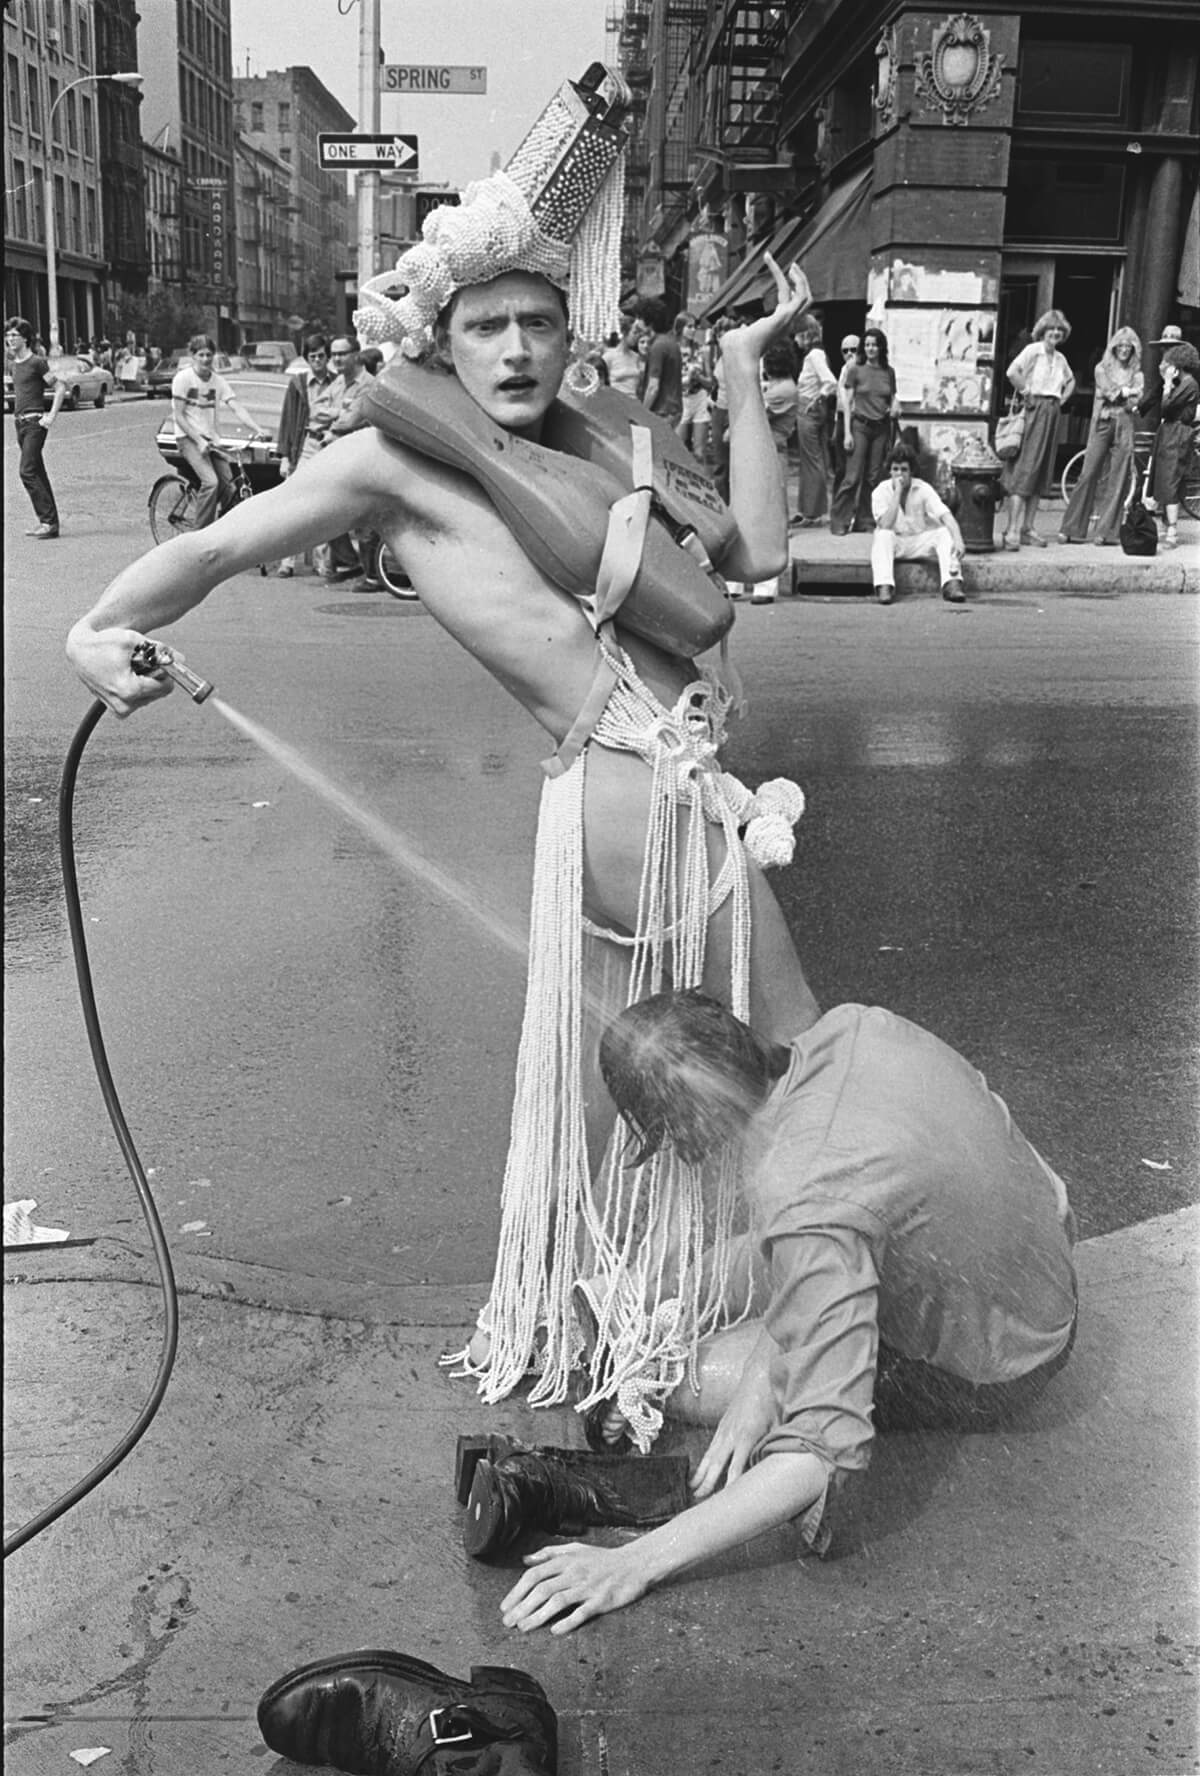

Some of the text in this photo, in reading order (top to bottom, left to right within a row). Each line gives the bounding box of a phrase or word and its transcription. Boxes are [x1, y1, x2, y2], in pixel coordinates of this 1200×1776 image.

[386, 68, 482, 89] SPRING ST
[328, 145, 404, 158] ONE WAY
[212, 191, 222, 284] HARDWARE
